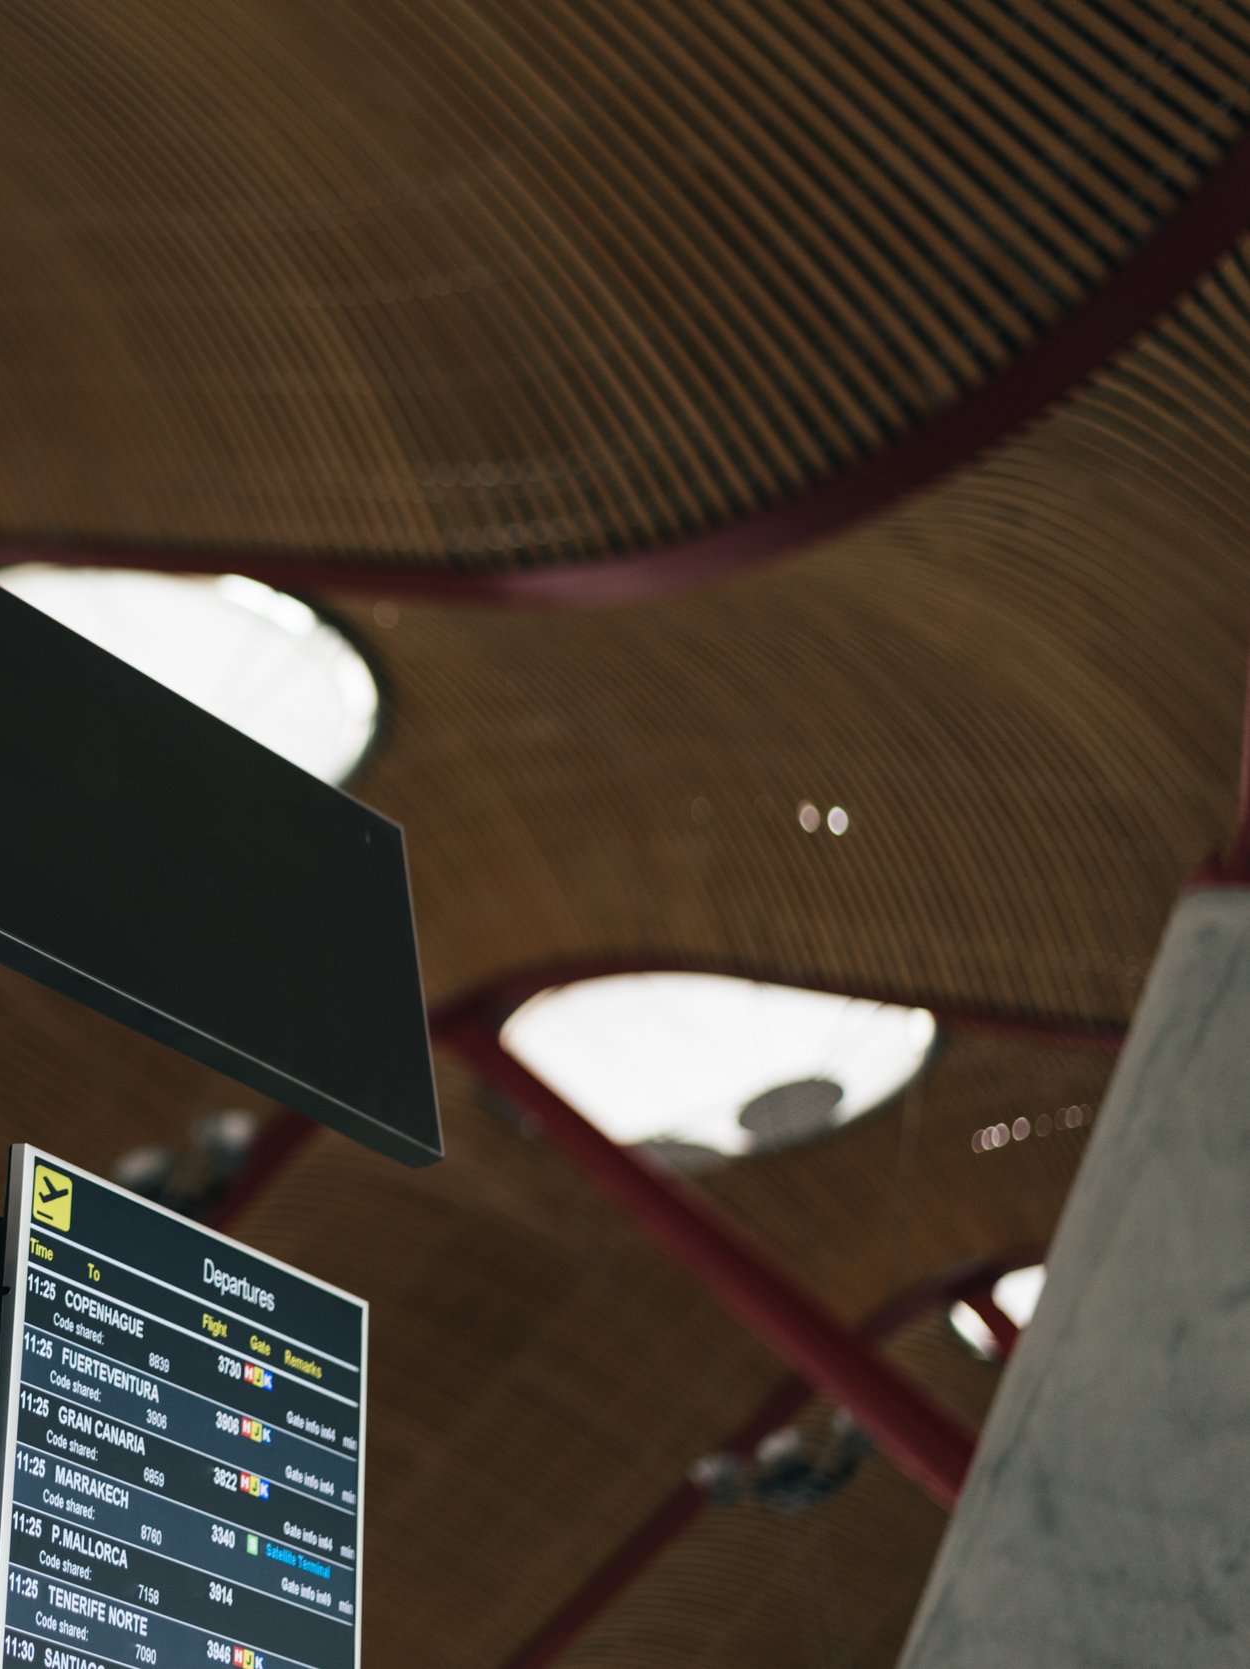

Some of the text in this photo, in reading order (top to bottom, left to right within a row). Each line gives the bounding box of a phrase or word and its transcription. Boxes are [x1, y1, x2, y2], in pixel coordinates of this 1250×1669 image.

[28, 1274, 56, 1300] 11:25
[65, 1290, 145, 1339] COPENHAGUE
[30, 1237, 271, 1357] Time To Flight Gate
[203, 1258, 275, 1312] Departures
[53, 1312, 105, 1345] Code shared:
[24, 1332, 160, 1402] 11:25 FUERTEVENTURA
[50, 1370, 102, 1402] Code shared:
[20, 1390, 145, 1456] 11:25 GRAN CANARIA
[46, 1430, 99, 1461] Code shared:
[17, 1451, 129, 1509] 11:25 MARRAKECH
[13, 1511, 128, 1569] 11:25 P.MALLORCA
[9, 1572, 148, 1637] 11:25 TENERIFE NORTE
[5, 1635, 35, 1662] 11:30
